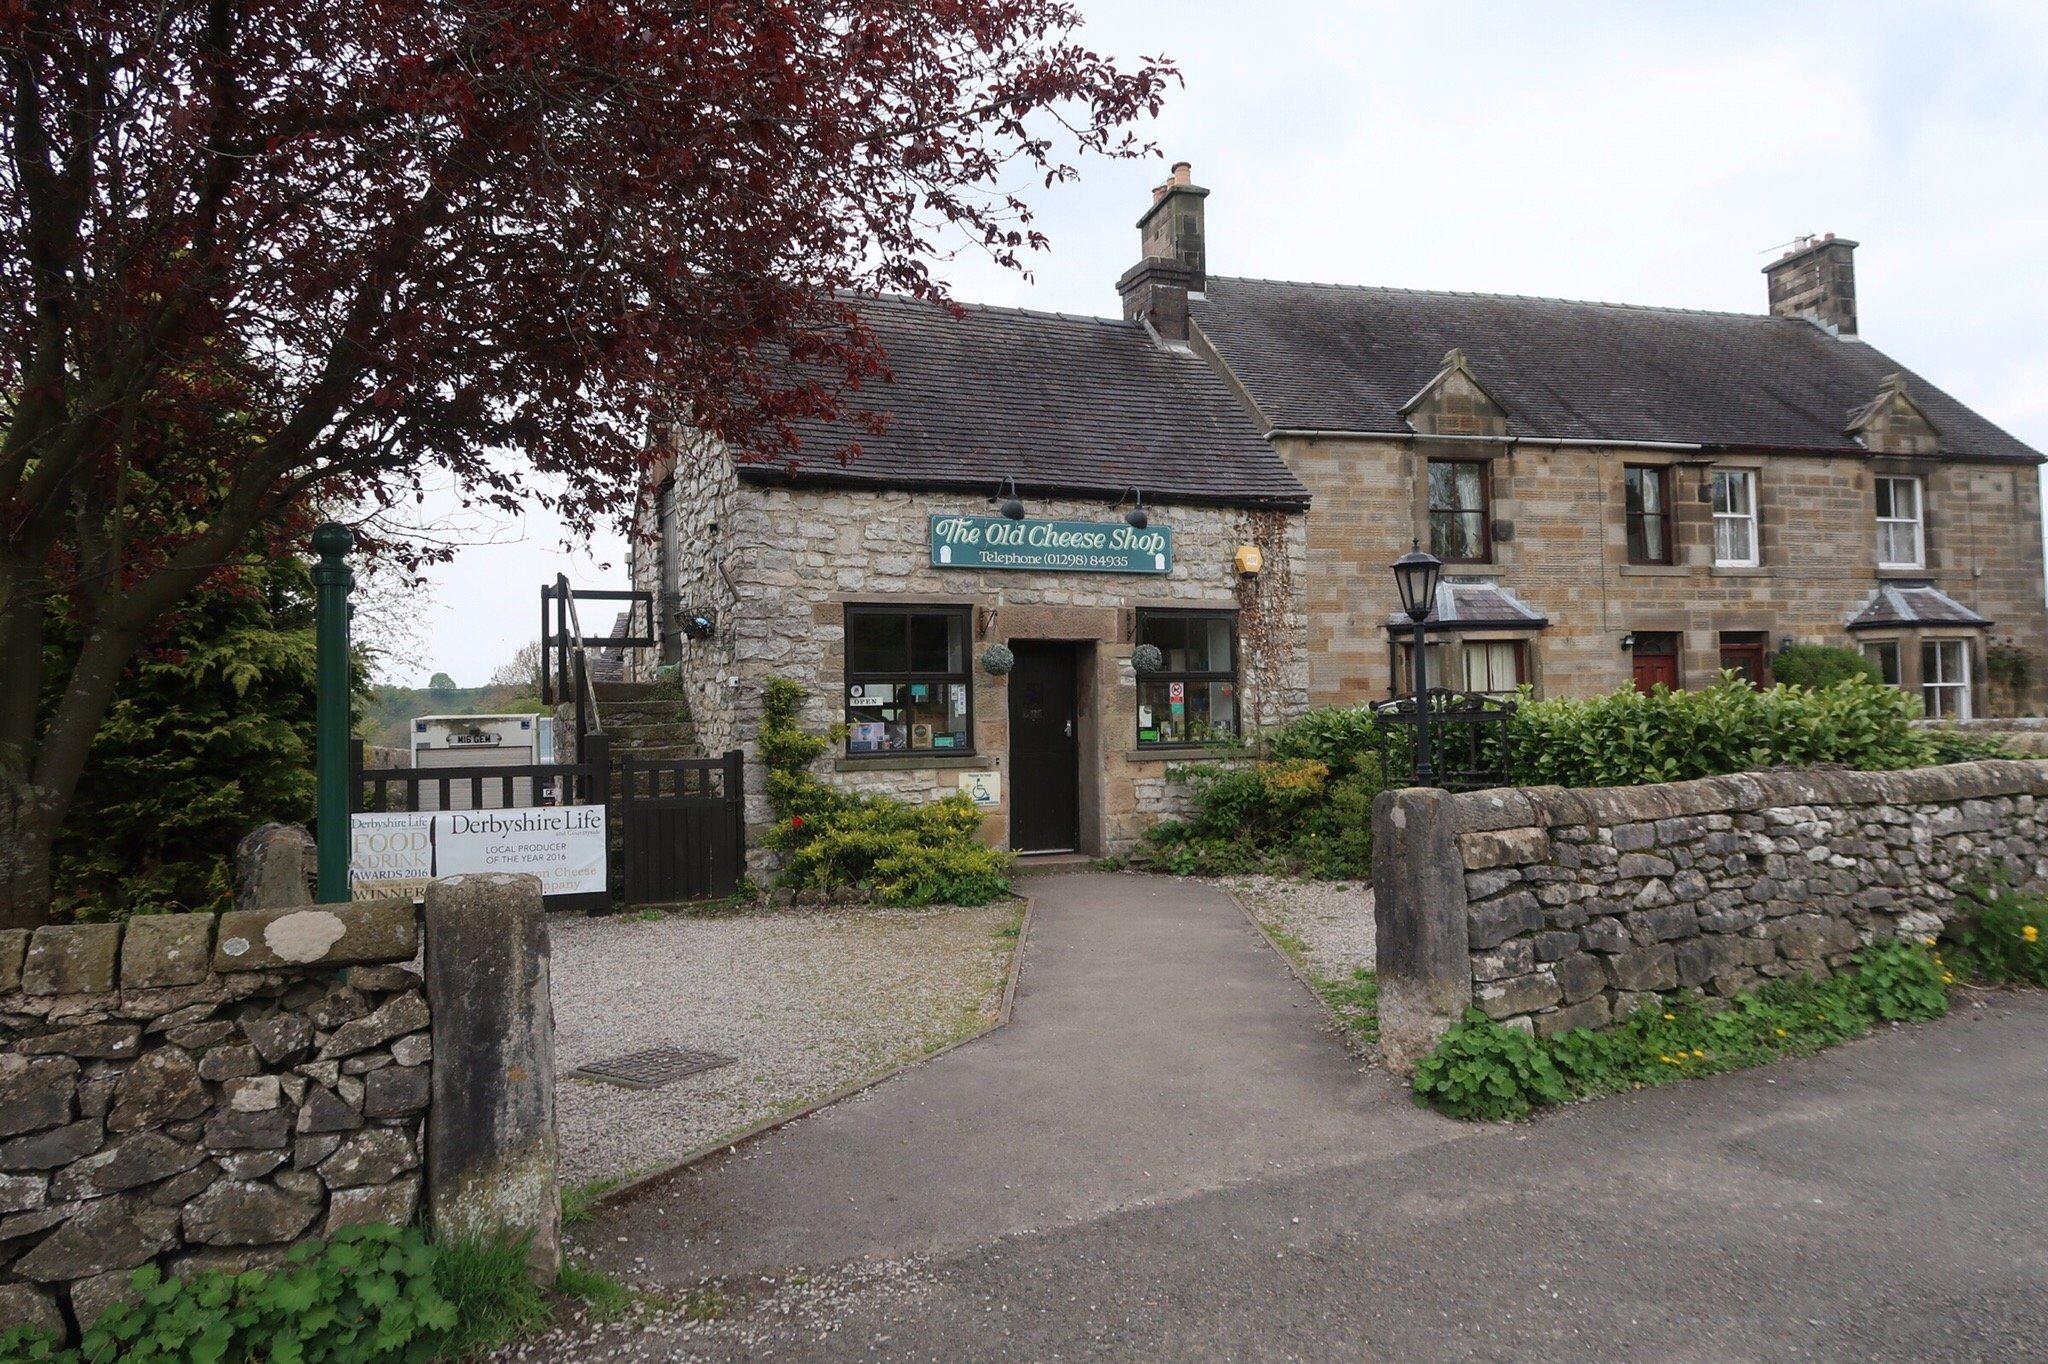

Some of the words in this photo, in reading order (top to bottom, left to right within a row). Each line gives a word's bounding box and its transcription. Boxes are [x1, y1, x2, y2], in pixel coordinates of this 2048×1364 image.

[936, 518, 981, 544] The
[985, 523, 1026, 546] Old
[1028, 523, 1107, 549] Cheese
[1109, 527, 1165, 556] Shop
[979, 551, 1042, 565] Telephone
[1043, 553, 1088, 566] (01298)
[1089, 555, 1129, 567] 84935
[352, 817, 407, 831] Derbyshire
[408, 816, 428, 827] Life
[452, 812, 561, 838] Derbyshire
[564, 809, 601, 830] Life
[354, 832, 428, 853] FOOD
[485, 846, 516, 854] LOCAL
[518, 843, 567, 852] PRODUCER
[367, 851, 427, 869] DRINK
[486, 856, 499, 864] OF
[501, 855, 519, 863] THE
[521, 854, 544, 862] YEAR
[546, 853, 567, 861] 2016
[353, 870, 403, 880] AWARDS
[405, 869, 428, 878] 2016
[554, 866, 598, 878] Cheese
[353, 886, 426, 900] WINNER
